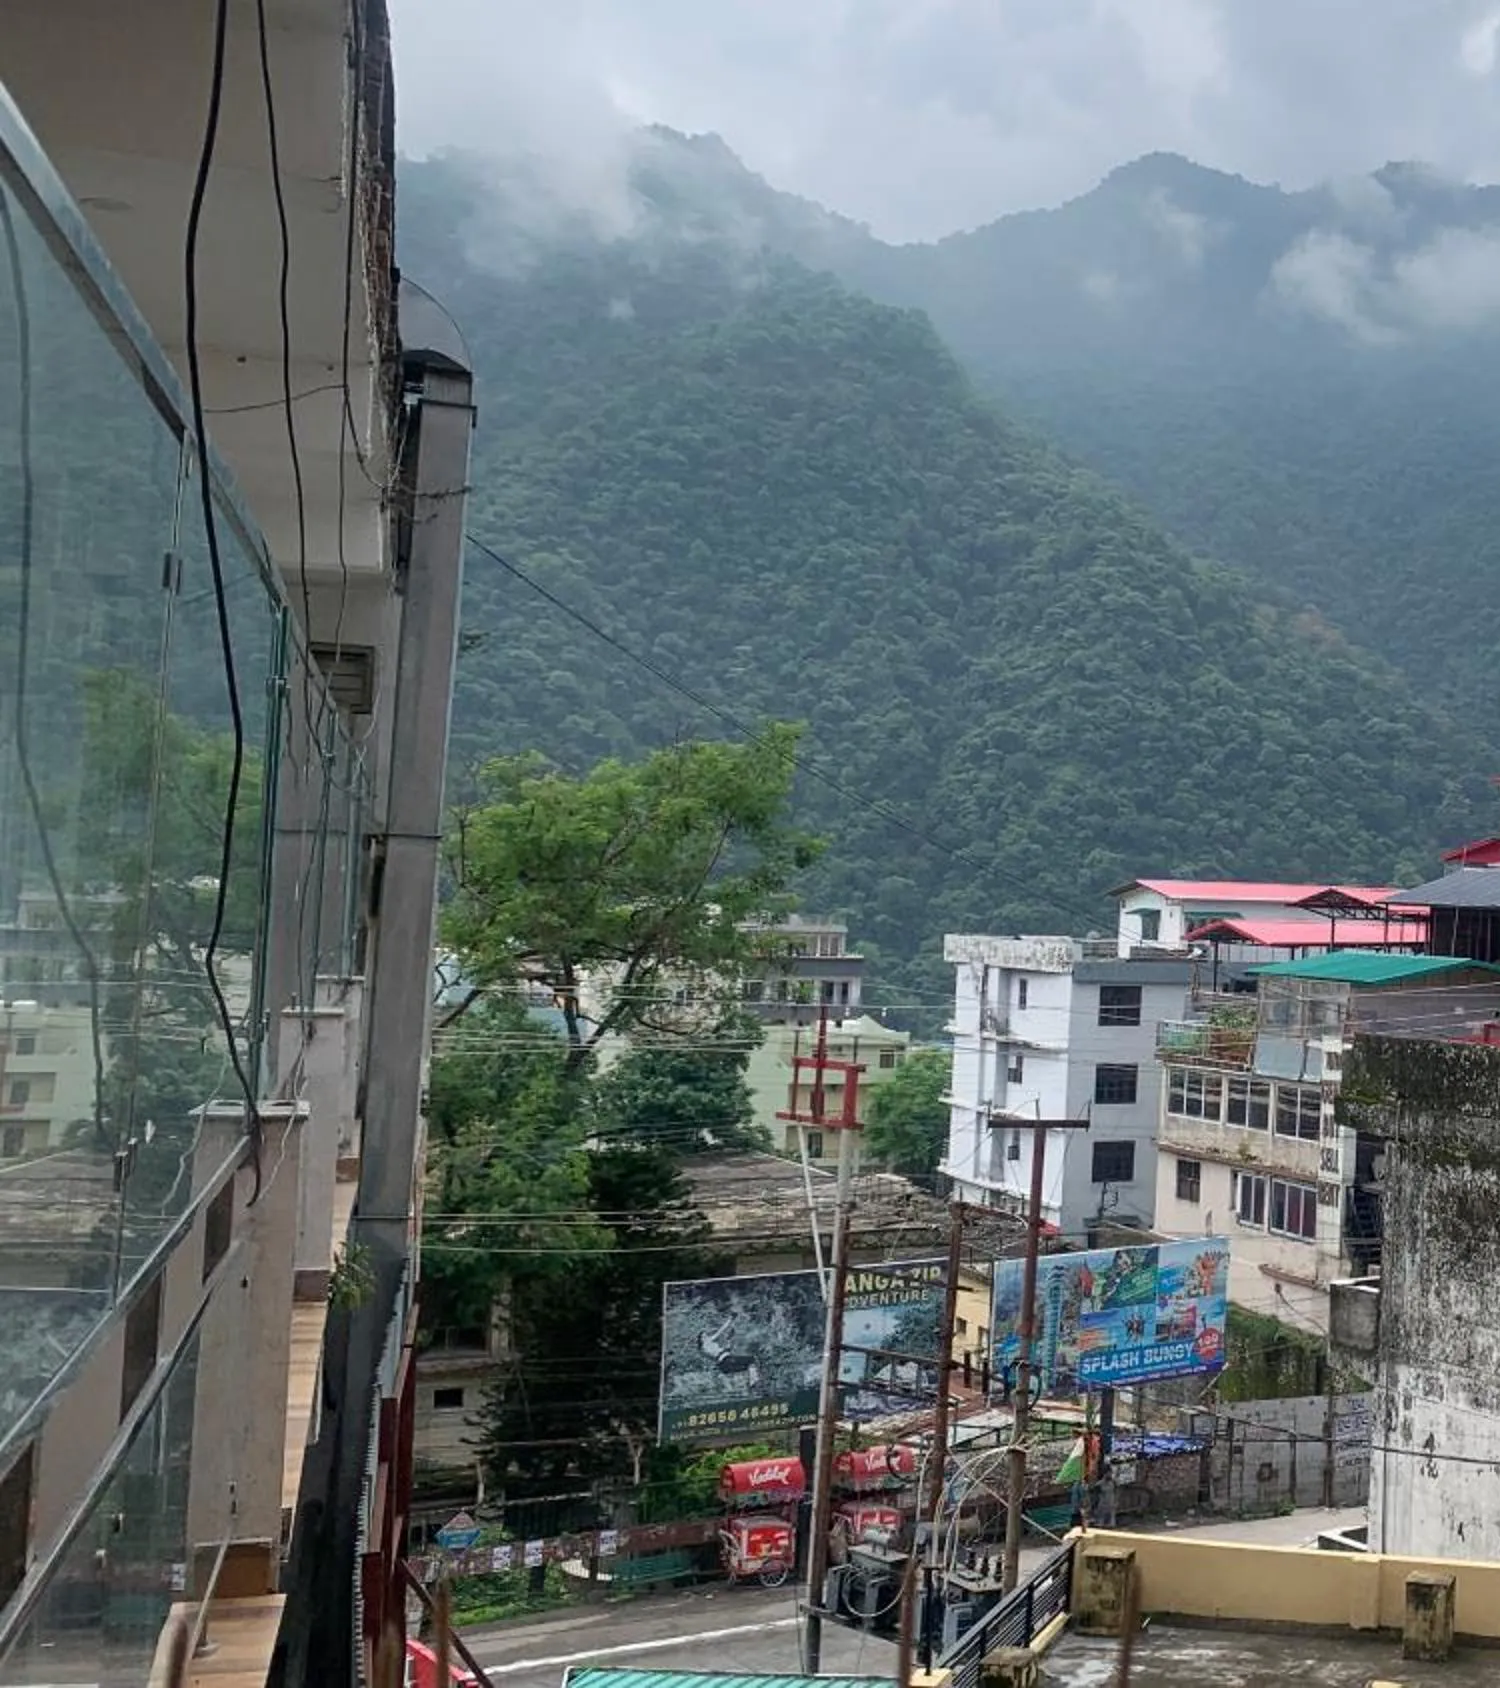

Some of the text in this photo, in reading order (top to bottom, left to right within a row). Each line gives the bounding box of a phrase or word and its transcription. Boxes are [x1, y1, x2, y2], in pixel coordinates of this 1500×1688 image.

[845, 1270, 906, 1293] ANGA
[844, 1288, 929, 1309] DVENTURE
[1081, 1352, 1139, 1374] SPLASH
[1143, 1342, 1193, 1363] BUNGY
